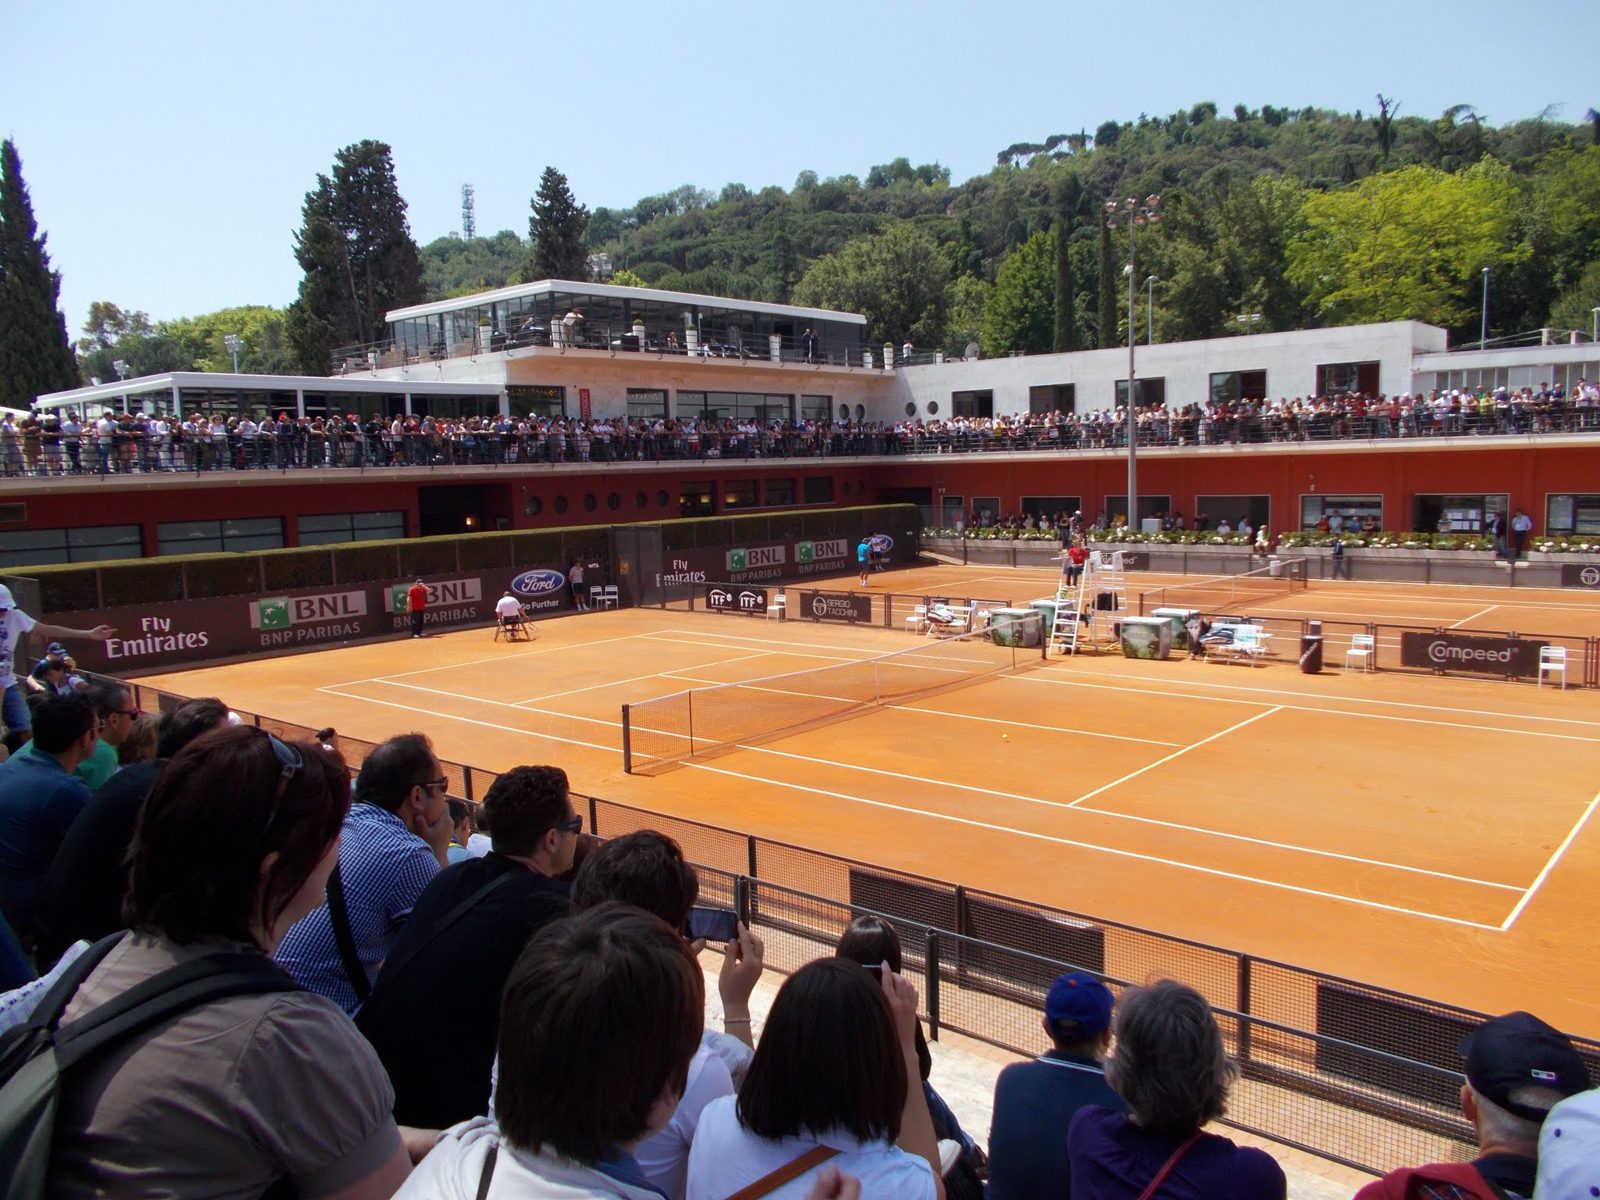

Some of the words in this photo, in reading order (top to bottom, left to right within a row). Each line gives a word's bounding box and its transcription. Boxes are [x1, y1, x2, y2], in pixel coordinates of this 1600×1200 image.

[748, 548, 781, 566] BNL
[815, 541, 844, 558] BNL
[673, 559, 688, 571] Fly
[798, 564, 814, 574] BNP
[815, 560, 846, 572] PARIBAS
[521, 573, 555, 592] Ford
[656, 571, 706, 588] Emirates
[730, 572, 747, 583] BNP
[749, 568, 782, 580] PARIBAS
[426, 582, 475, 604] BNL
[710, 595, 725, 605] ITF
[295, 595, 359, 621] BNL
[531, 600, 559, 609] Further
[740, 597, 756, 608] ITF
[827, 599, 850, 608] SERGIO
[423, 607, 477, 623] PARIBAS
[827, 607, 857, 617] TACCHINI
[141, 617, 170, 632] Fly
[261, 631, 293, 646] BNP
[297, 622, 361, 640] PARIBAS
[105, 631, 209, 659] Emirates
